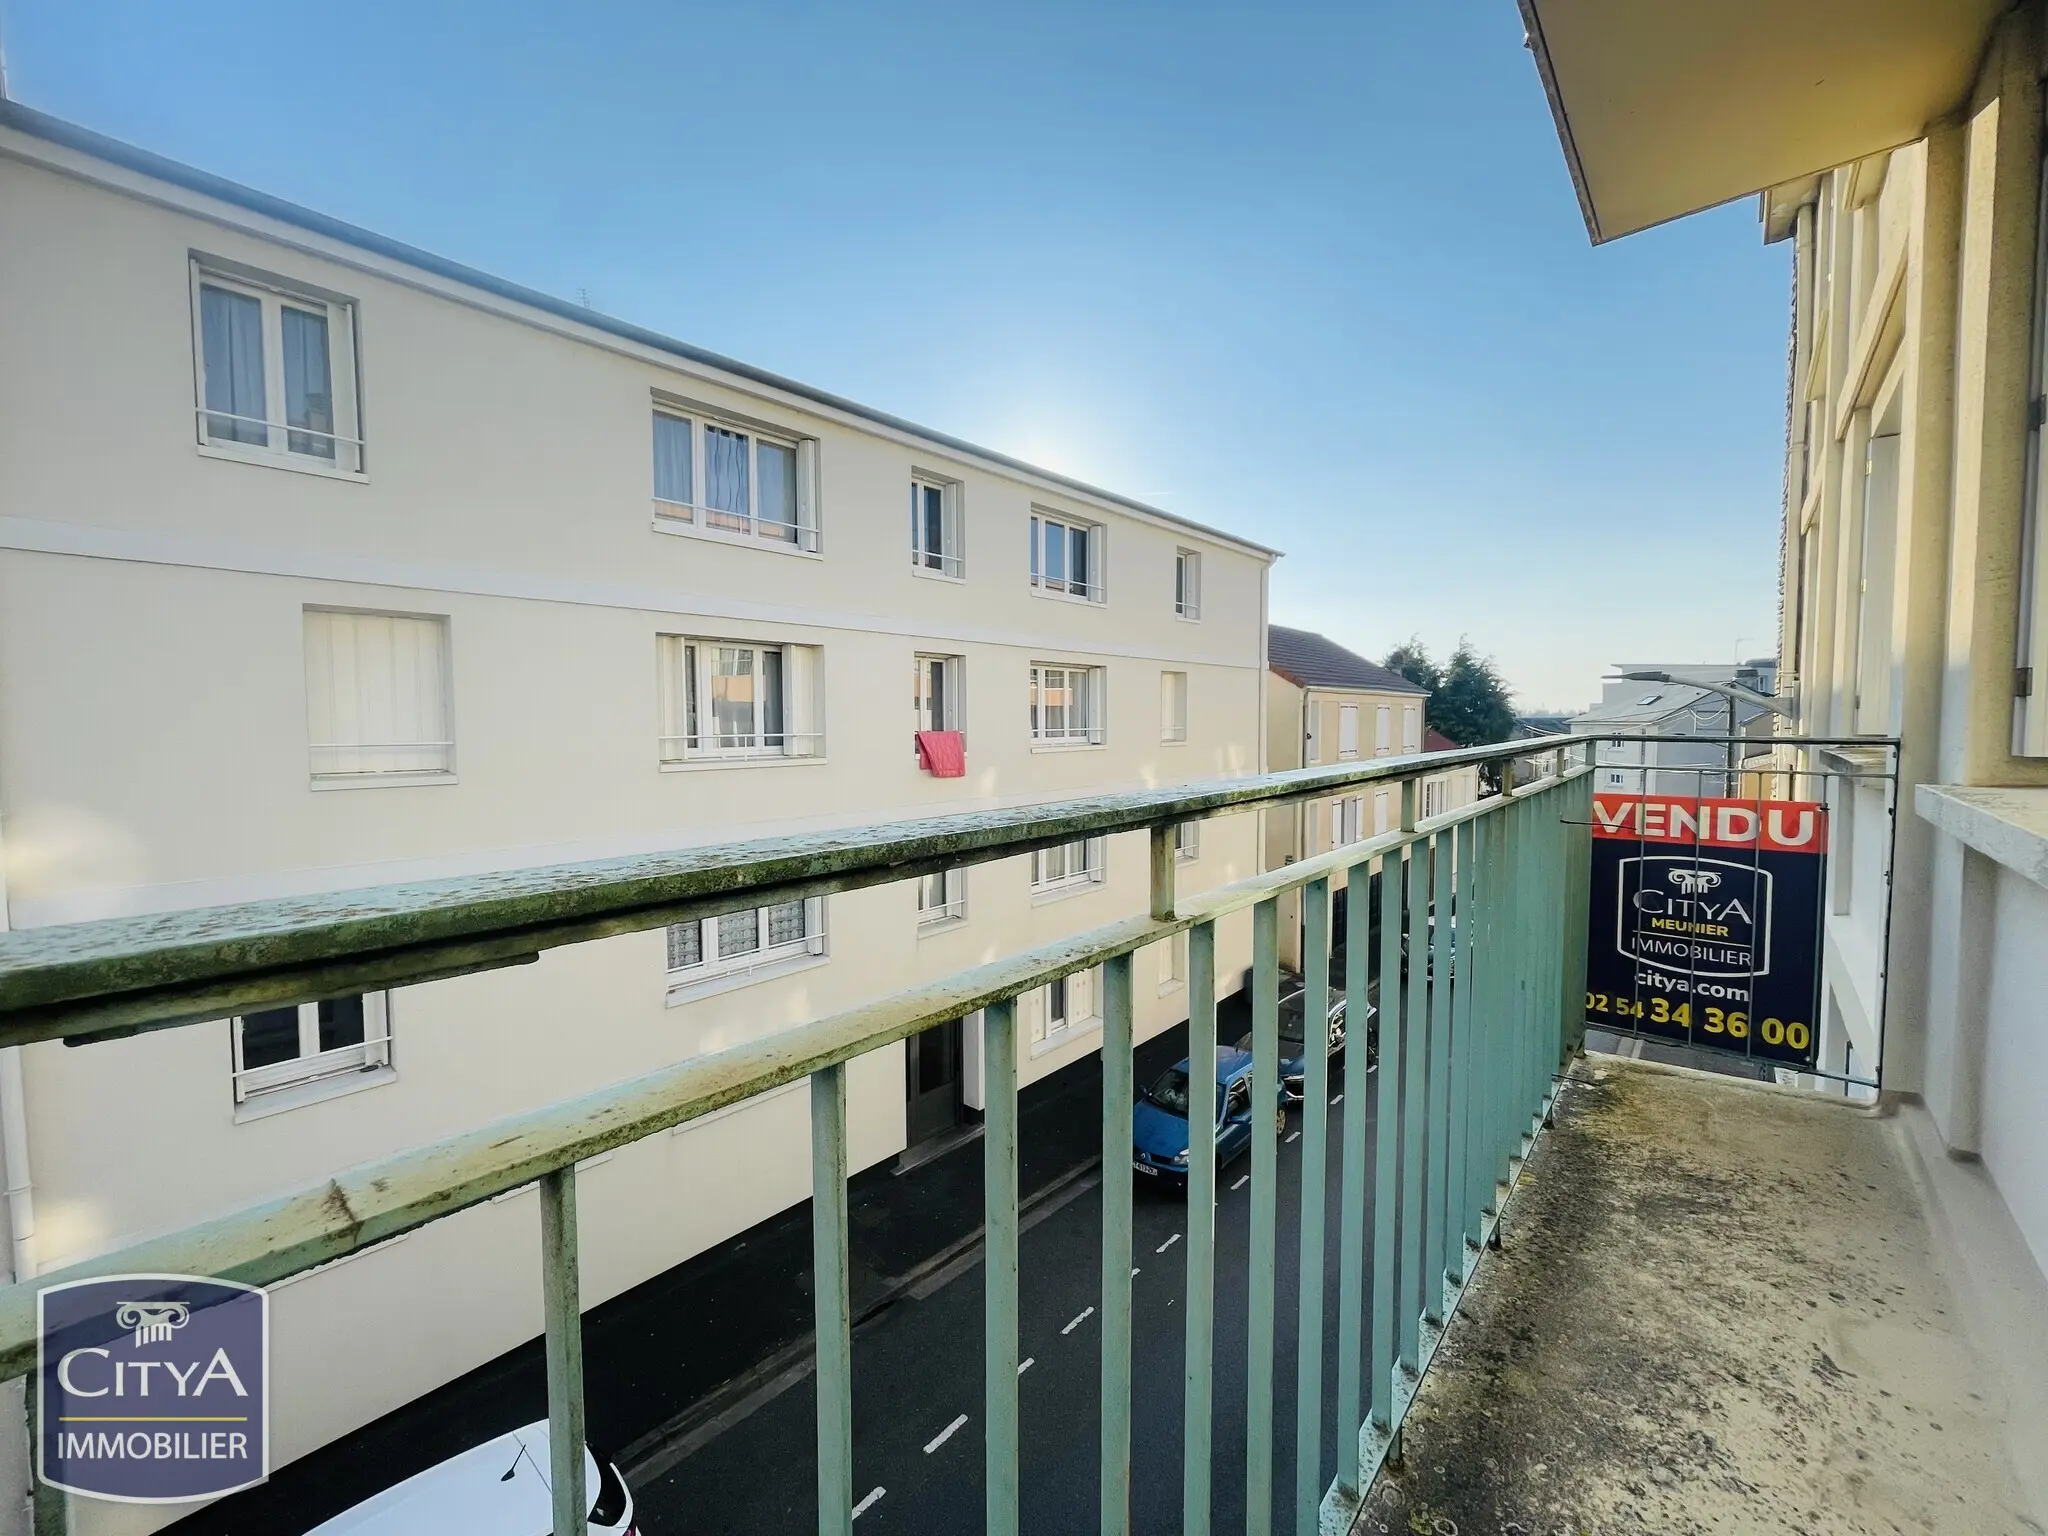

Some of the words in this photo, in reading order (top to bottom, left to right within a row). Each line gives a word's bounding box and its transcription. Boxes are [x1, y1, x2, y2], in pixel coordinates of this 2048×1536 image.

[1594, 801, 1813, 845] VENDU
[1651, 917, 1729, 937] MEUNIER
[1632, 937, 1751, 966] IMMOBILIER
[1634, 969, 1750, 1002] citya.com
[1585, 992, 1608, 1013] 02
[1616, 998, 1644, 1018] 54
[1650, 998, 1690, 1028] 34
[1704, 1007, 1748, 1039] 36
[1761, 1017, 1810, 1049] 00
